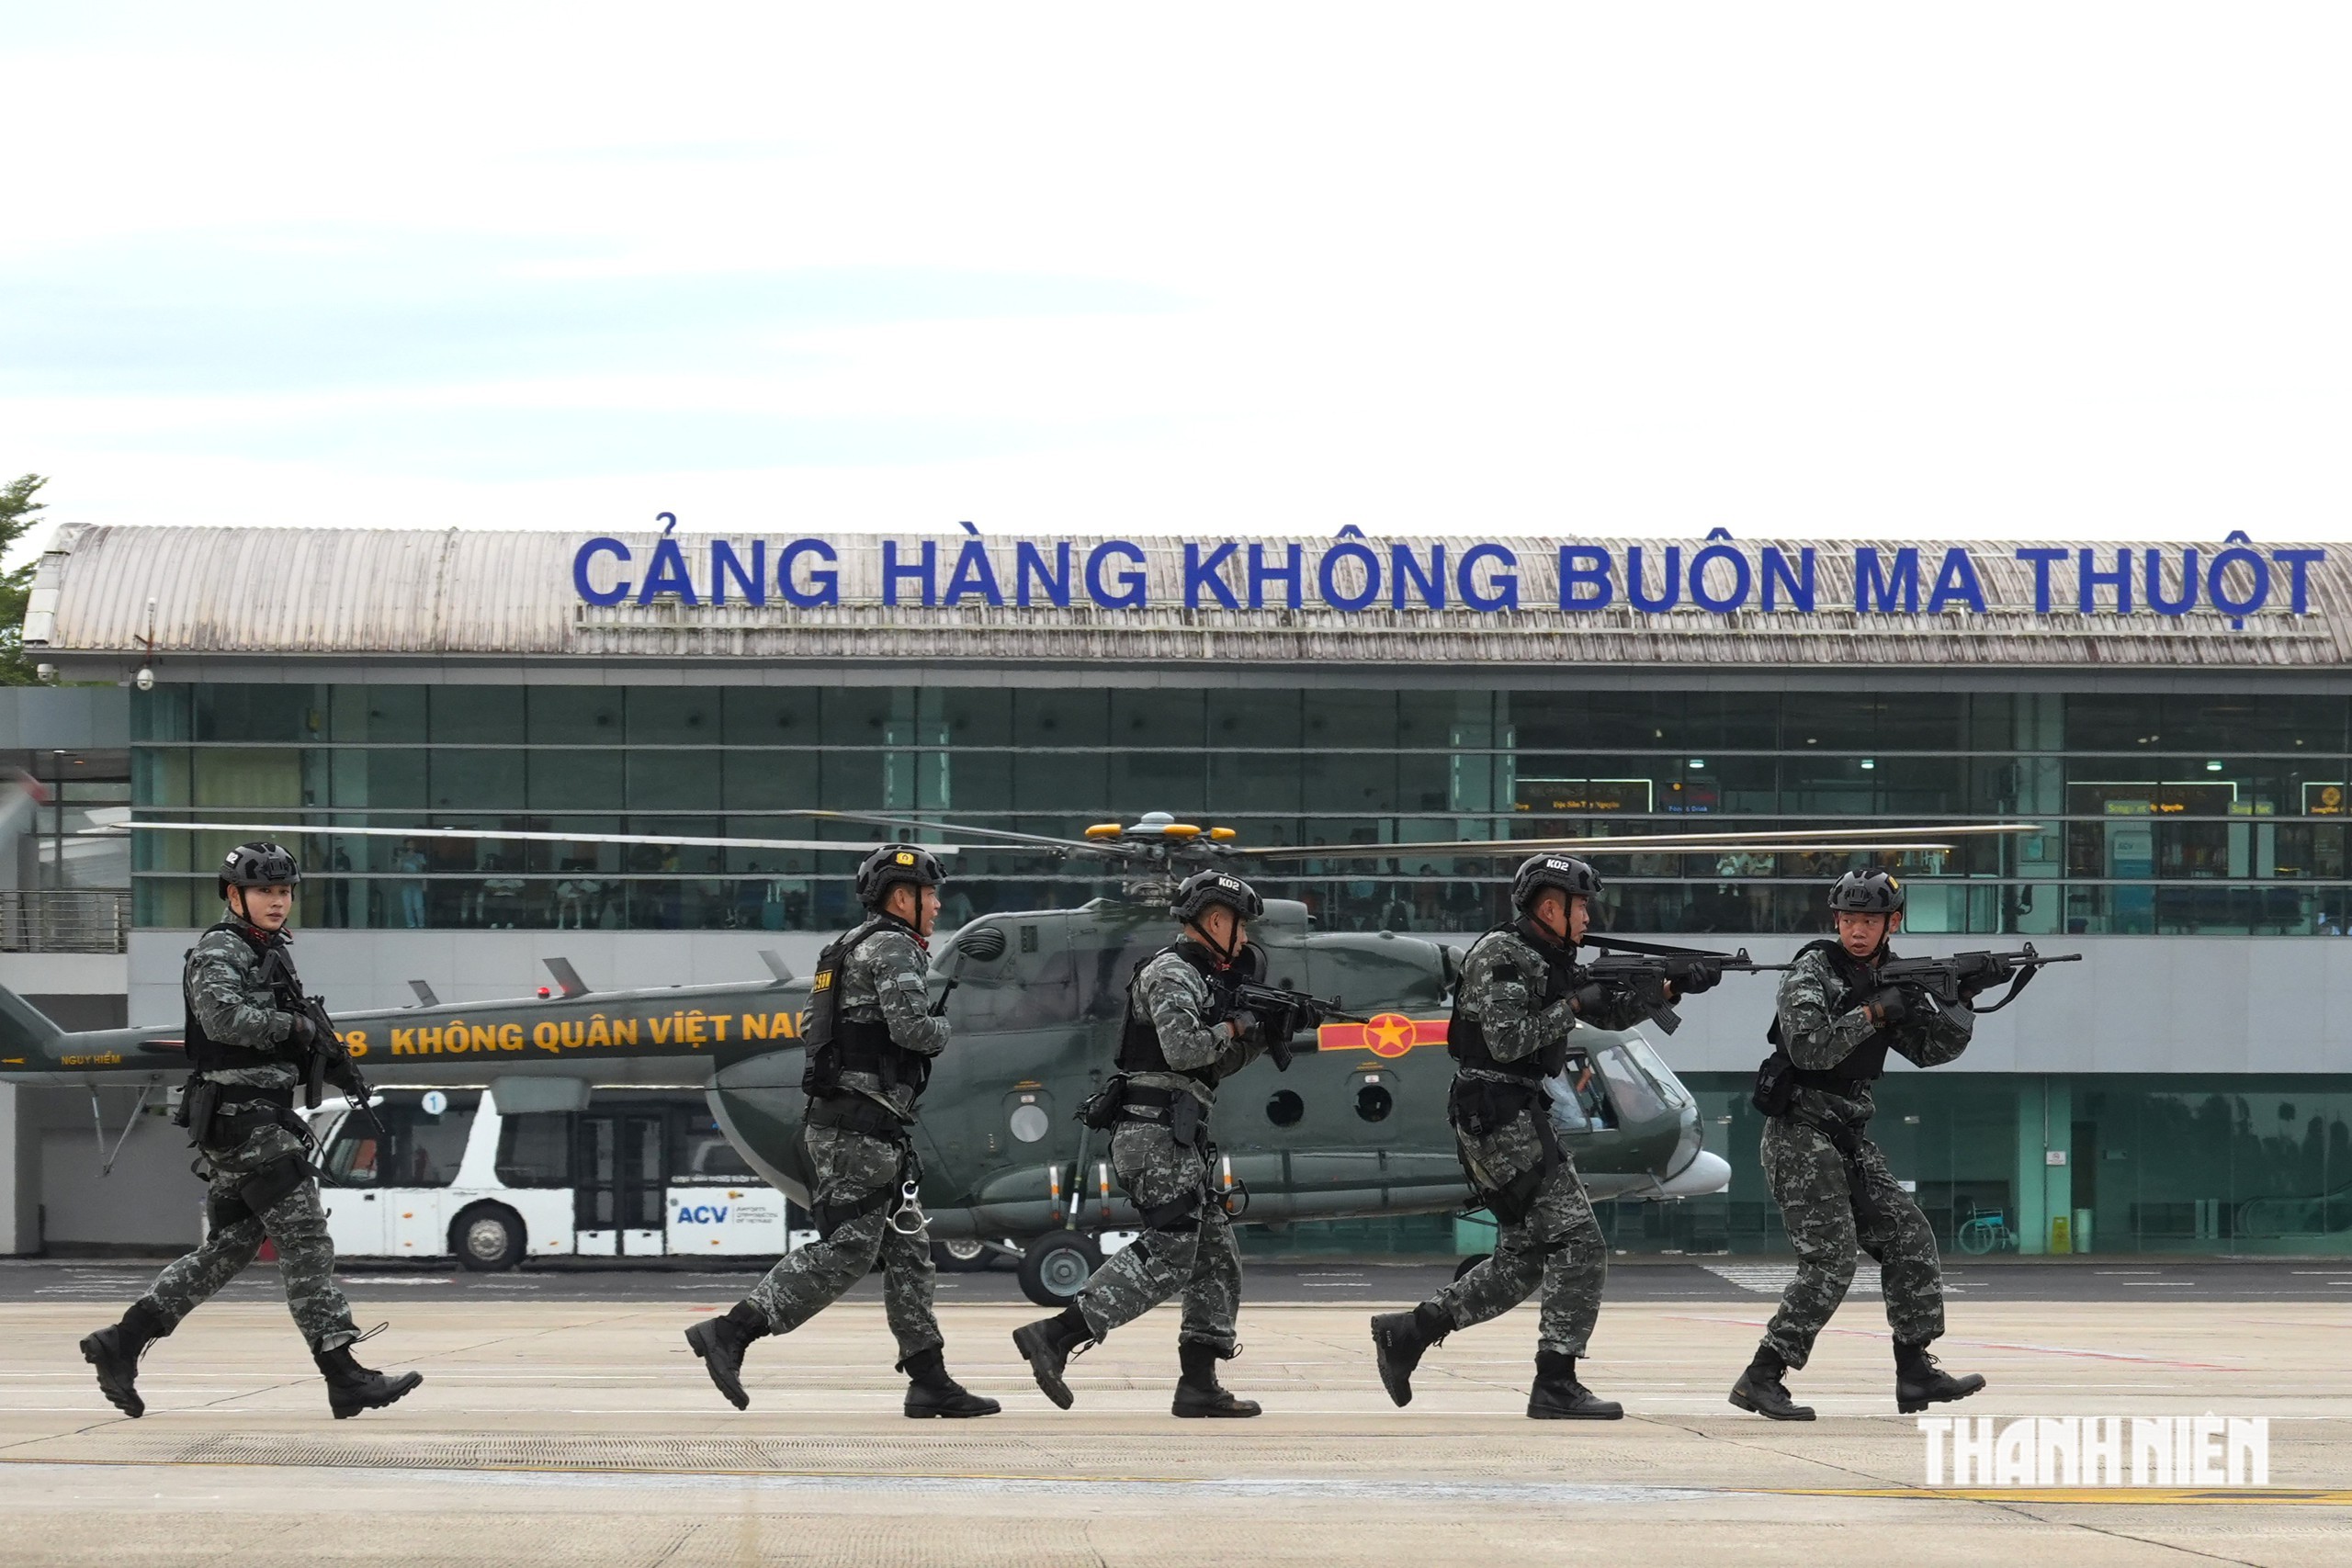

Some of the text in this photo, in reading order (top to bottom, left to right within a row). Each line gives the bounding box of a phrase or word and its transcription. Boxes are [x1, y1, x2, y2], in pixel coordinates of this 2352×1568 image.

[573, 512, 2325, 630] CẢNG HÀNG KHÔNG BUÔN MA THUỘT
[390, 1020, 524, 1055] KHÔNG
[533, 1013, 639, 1054] QUÂN
[61, 1055, 92, 1066] NGUY
[429, 1096, 437, 1111] 1
[677, 1206, 728, 1224] ACV
